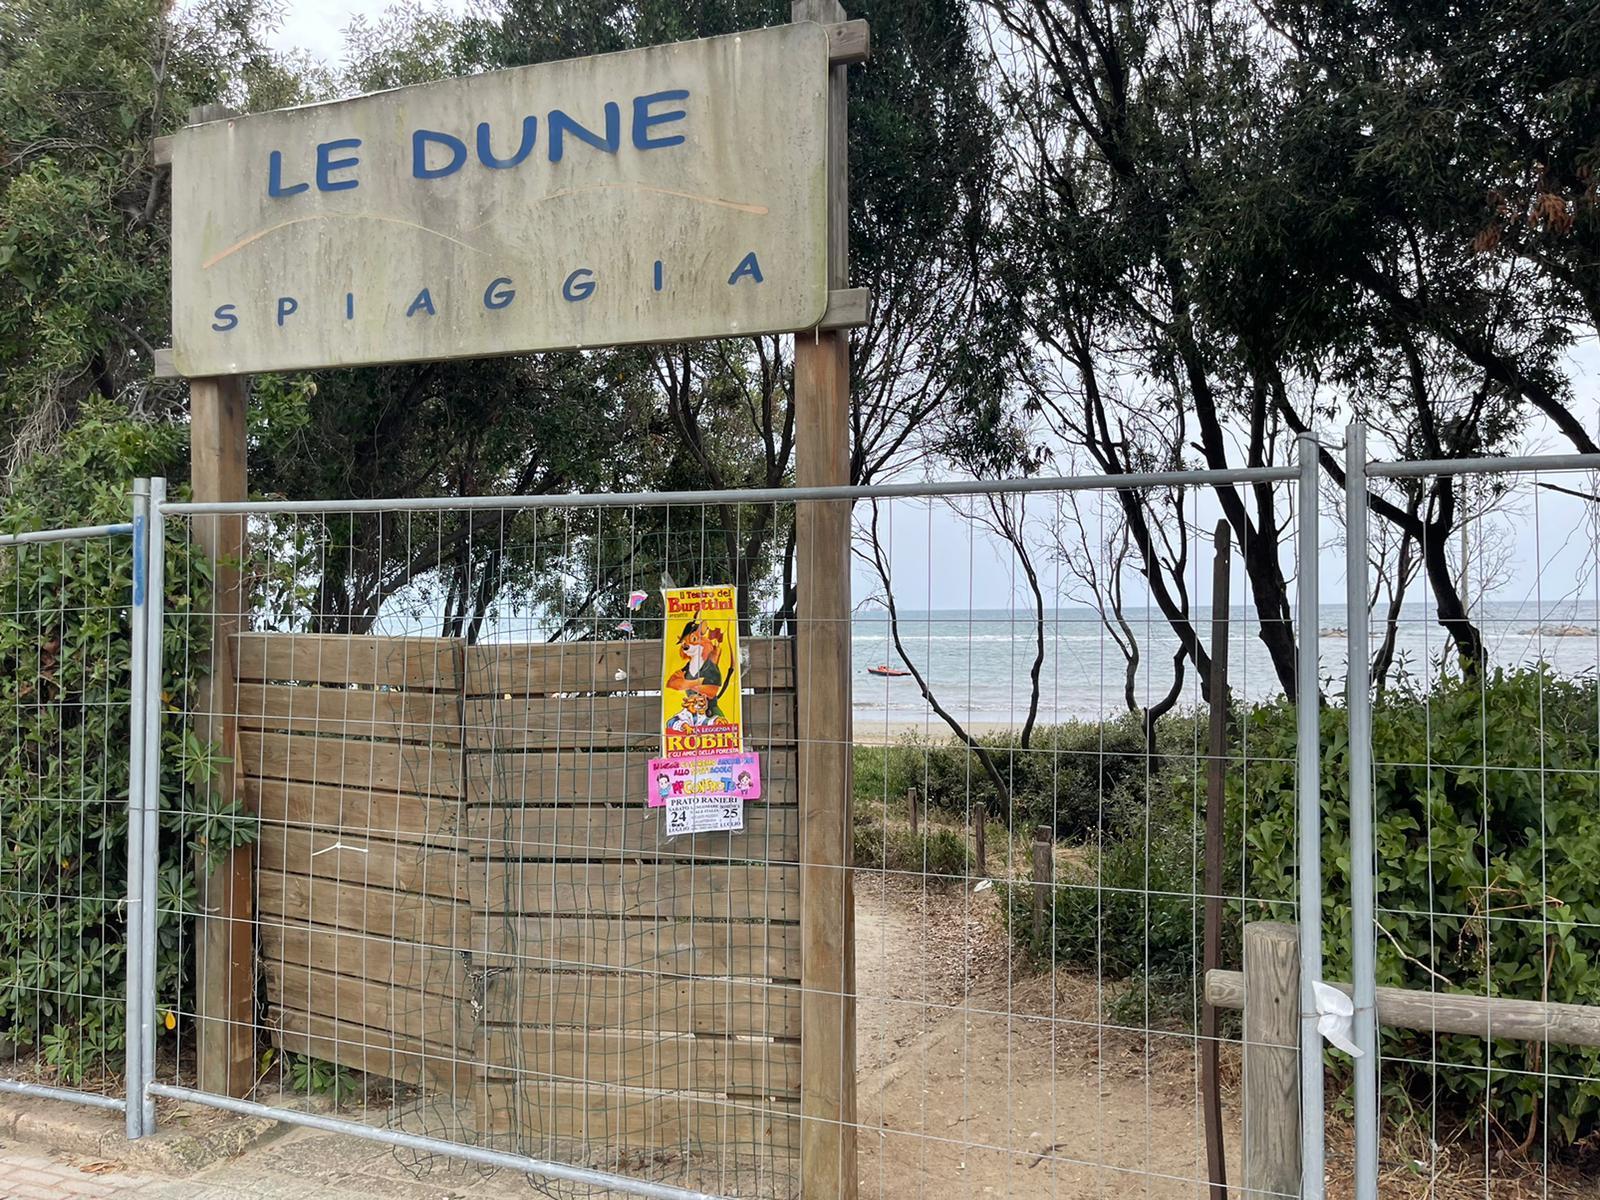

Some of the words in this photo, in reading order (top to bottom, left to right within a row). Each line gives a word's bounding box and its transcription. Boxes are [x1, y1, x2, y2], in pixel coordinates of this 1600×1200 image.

[268, 138, 362, 198] LE
[411, 89, 690, 181] DUNE
[211, 251, 764, 332] SPIAGGIA
[686, 591, 715, 599] Teatro
[668, 597, 734, 613] Burattini
[667, 732, 739, 751] ROBIN
[673, 769, 690, 777] ALLO
[670, 797, 699, 806] PRATO
[701, 796, 738, 804] RANIERI
[671, 811, 687, 823] 24
[723, 808, 738, 818] 25
